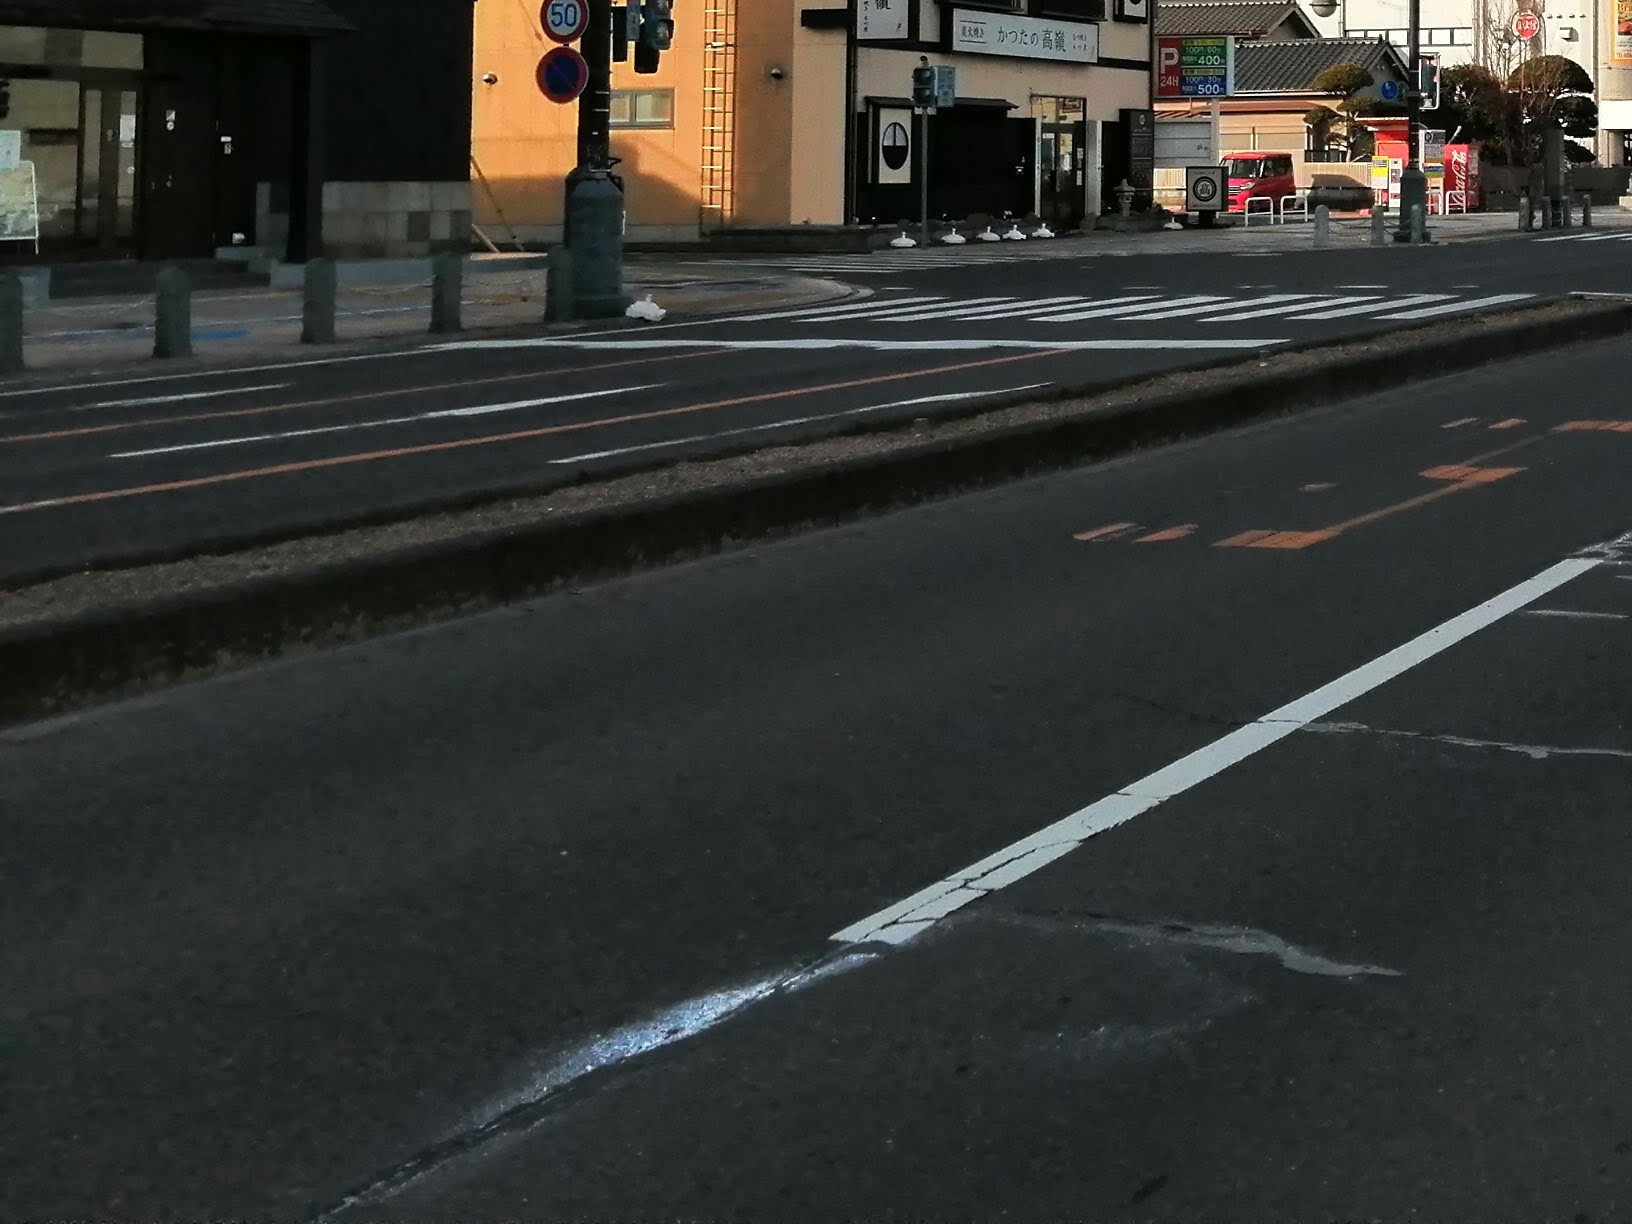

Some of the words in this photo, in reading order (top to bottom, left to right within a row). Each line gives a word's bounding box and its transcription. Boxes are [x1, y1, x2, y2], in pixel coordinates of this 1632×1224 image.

[551, 3, 577, 27] 50
[998, 27, 1066, 52] かつたの高嶺
[1161, 47, 1179, 74] P
[1160, 76, 1179, 86] 24H
